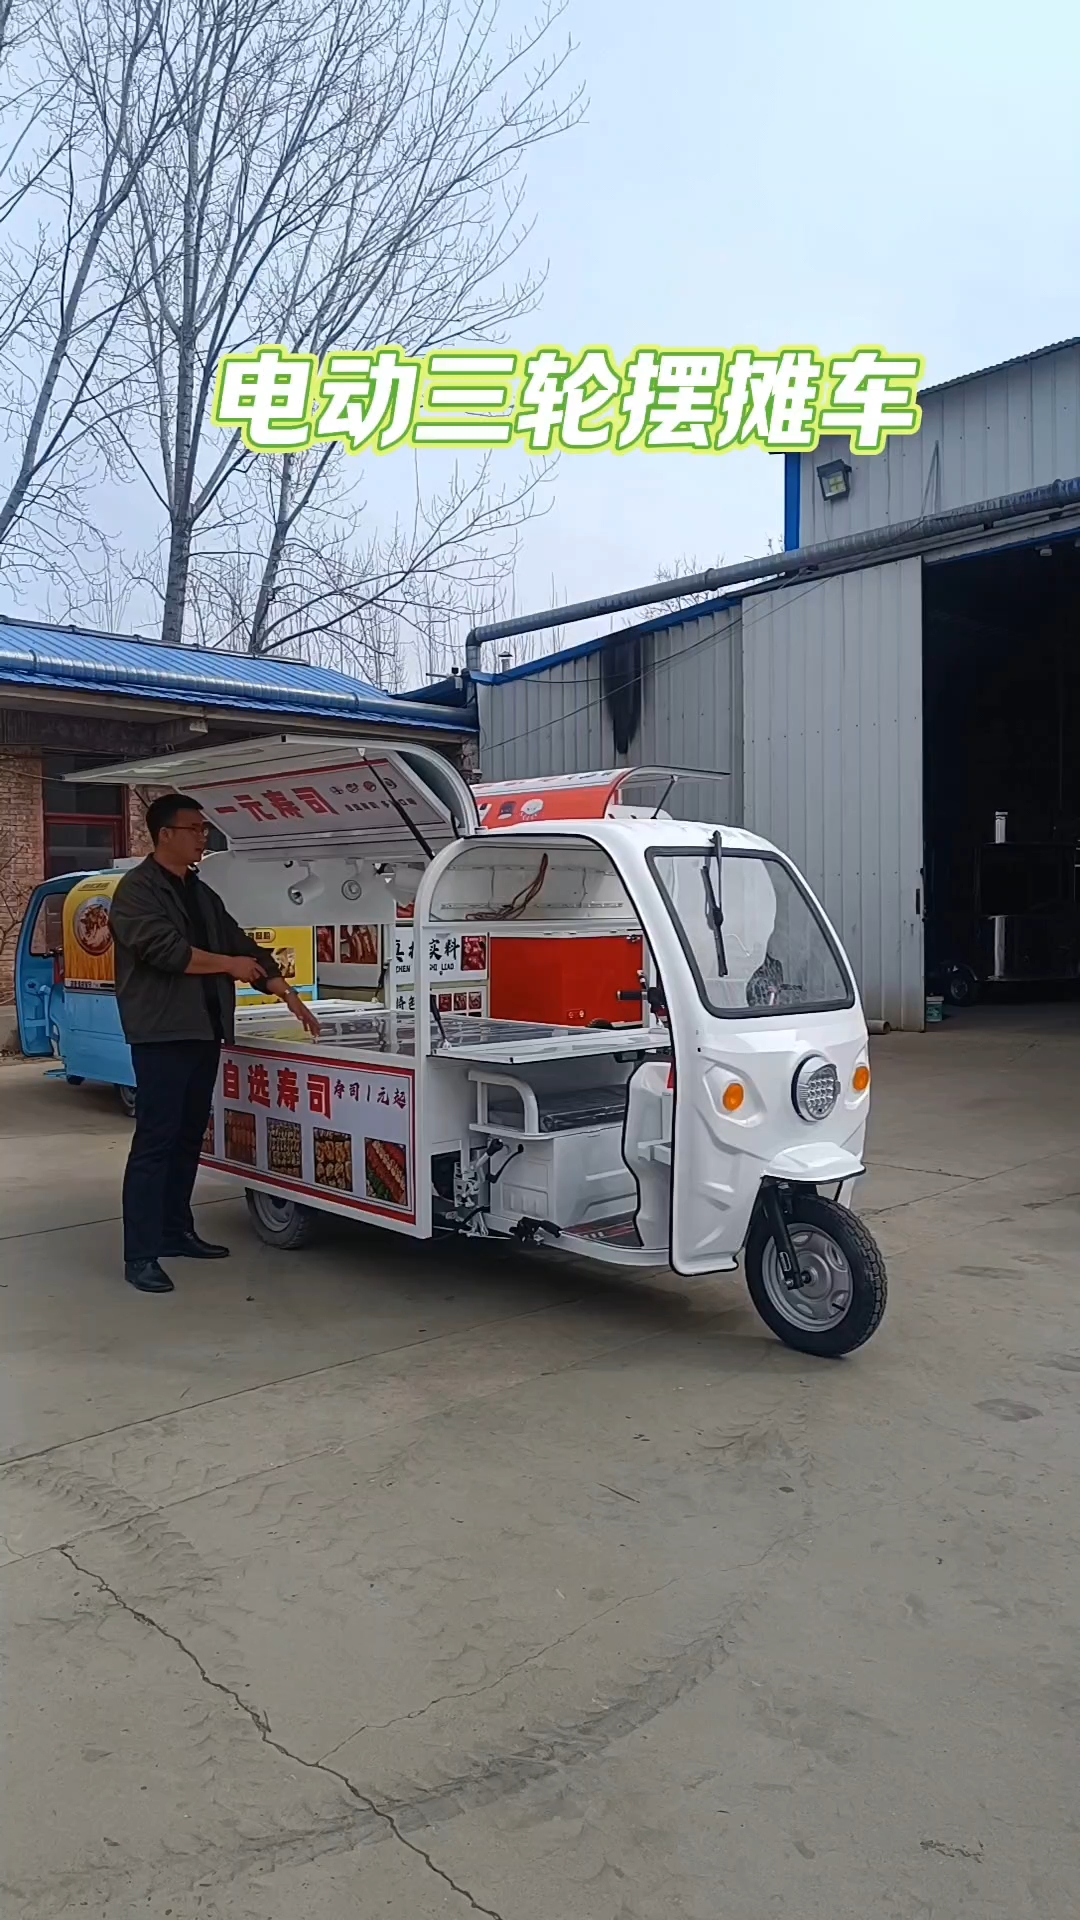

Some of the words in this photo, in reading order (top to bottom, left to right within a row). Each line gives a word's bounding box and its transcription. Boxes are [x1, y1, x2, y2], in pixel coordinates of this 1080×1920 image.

[214, 786, 340, 822] 一元寿司
[223, 1059, 332, 1120] 自选寿司
